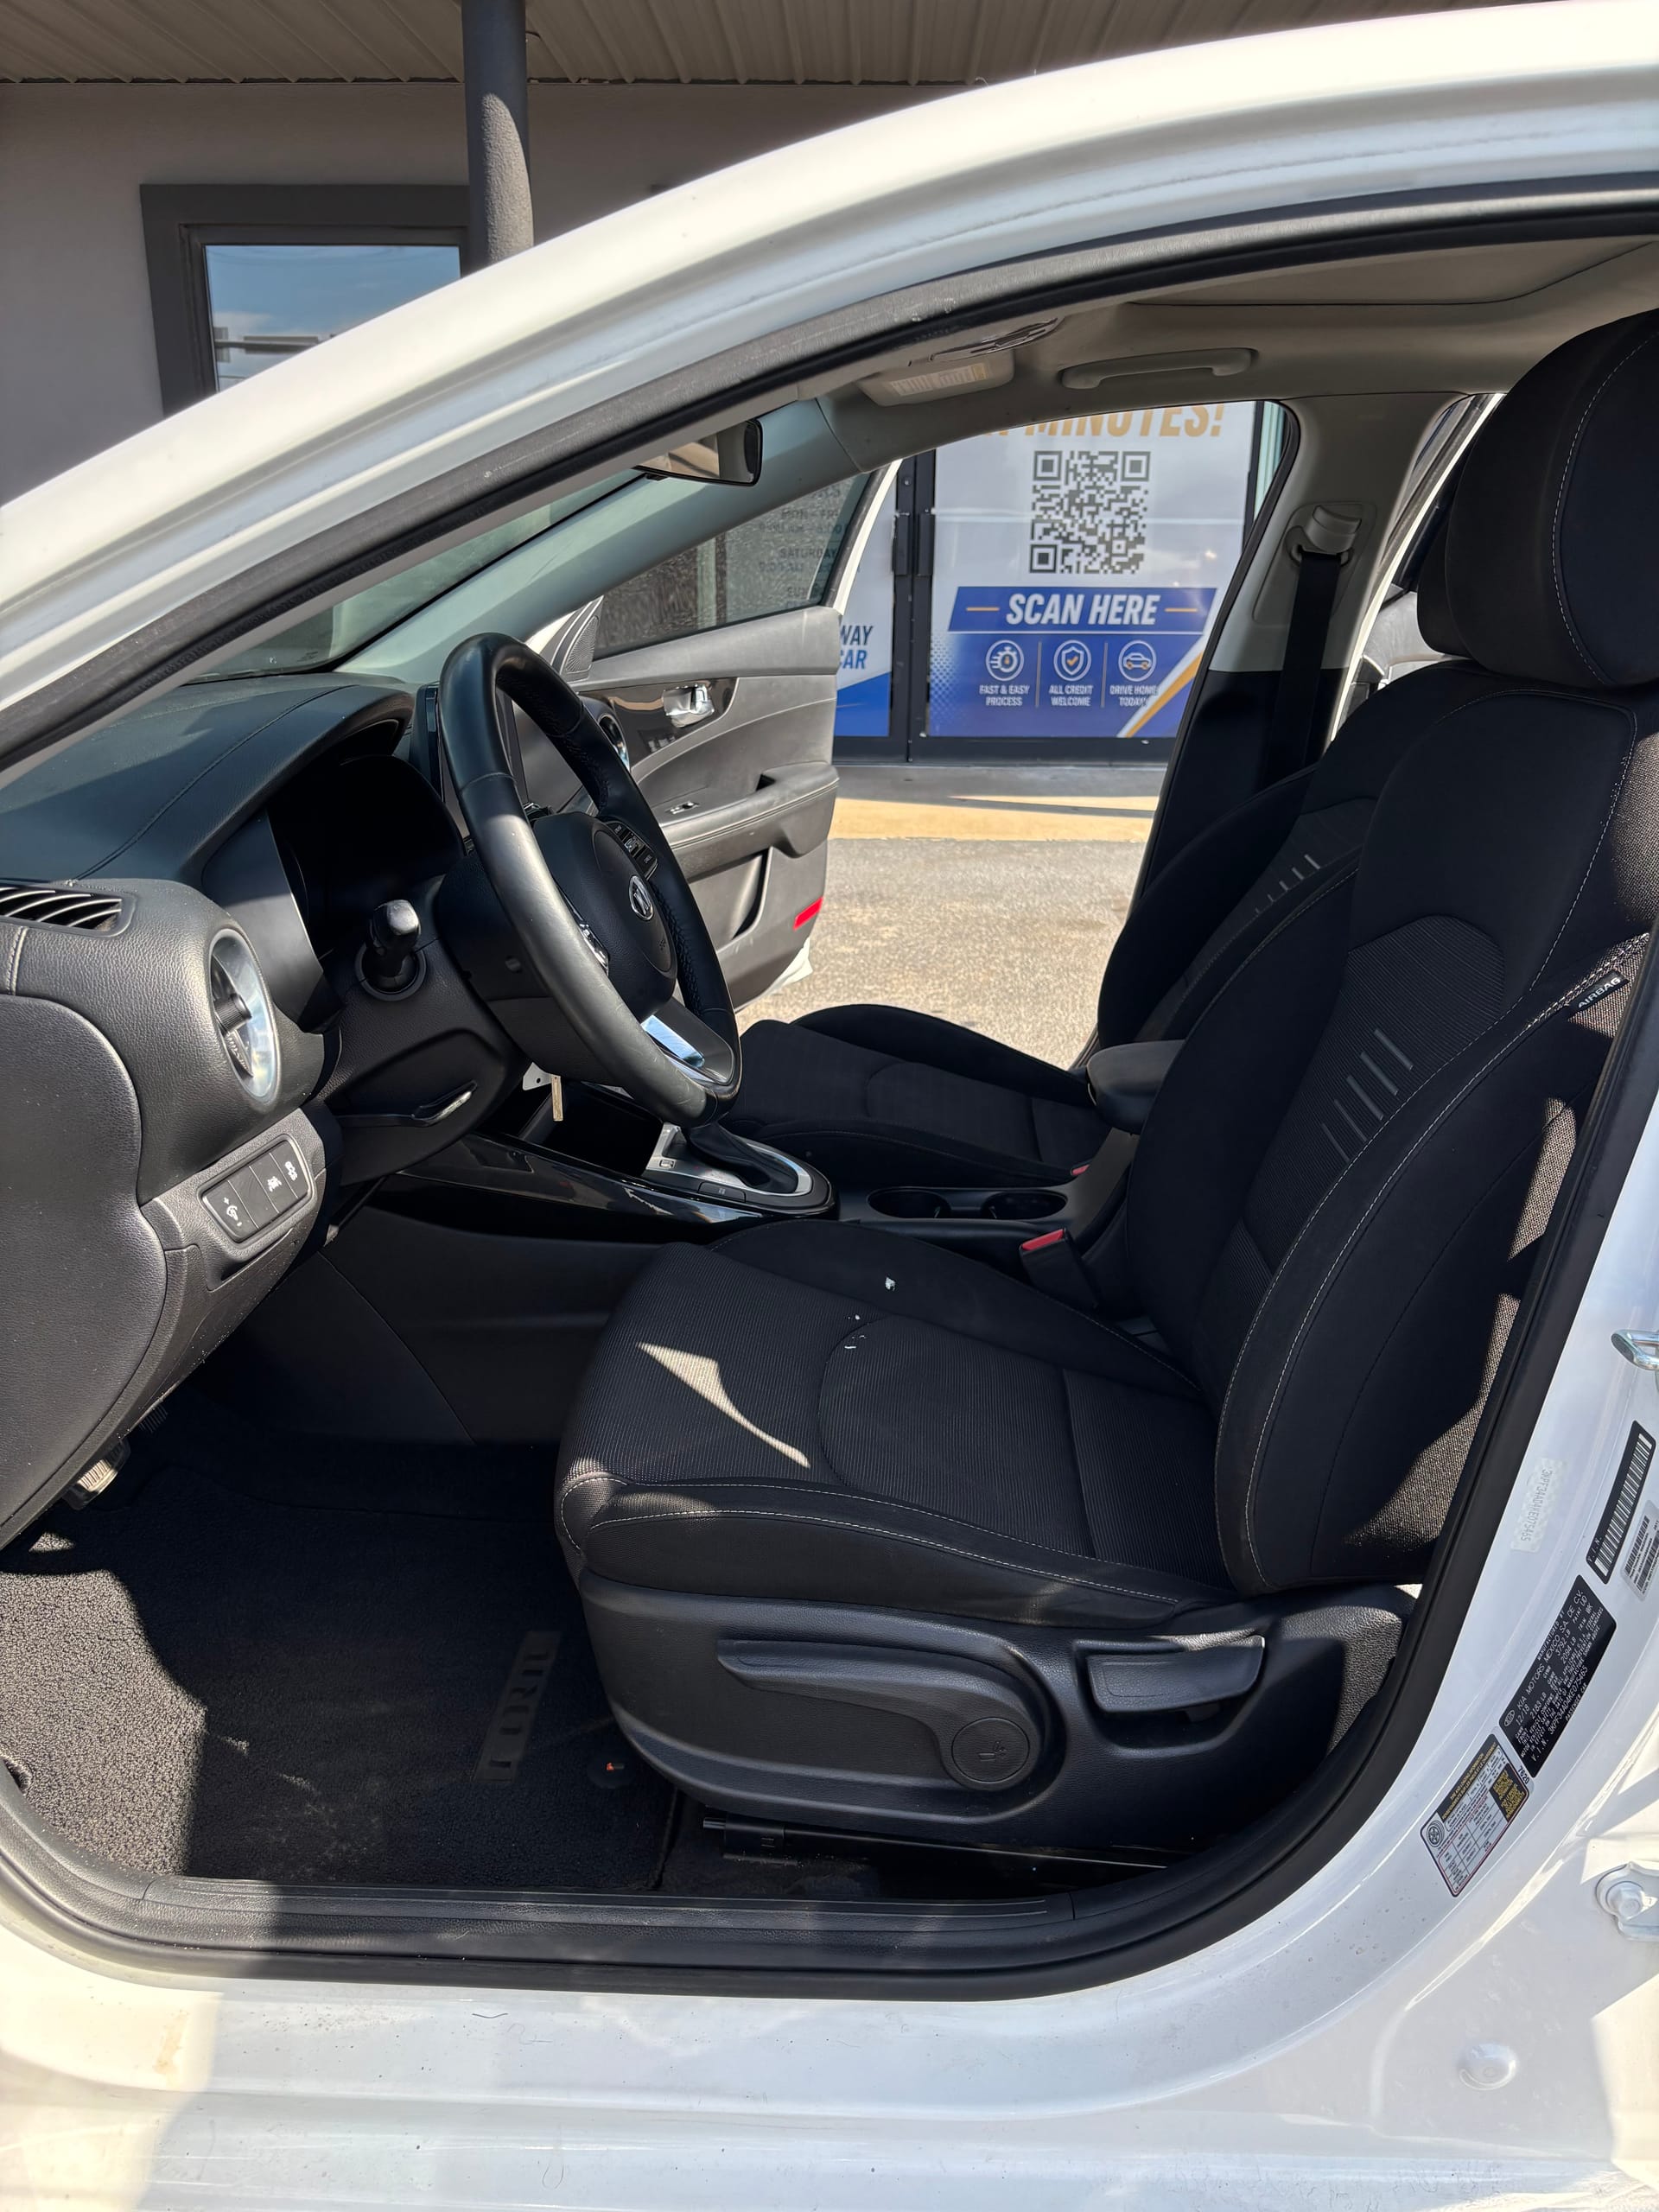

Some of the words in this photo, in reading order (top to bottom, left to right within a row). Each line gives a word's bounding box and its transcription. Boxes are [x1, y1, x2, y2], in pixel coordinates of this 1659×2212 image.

[1006, 594, 1084, 625] SCAN
[1088, 594, 1161, 625] HERE
[841, 649, 867, 669] AR
[979, 684, 999, 694] FAST
[1009, 684, 1030, 694] EASY
[1048, 684, 1062, 694] ALL
[1064, 684, 1093, 694] CREDIT
[1109, 685, 1134, 695] DRIVE
[986, 696, 1022, 706] PROCESS
[1052, 697, 1090, 706] WELCOME
[1578, 977, 1621, 1008] AIRBAG
[1516, 1695, 1526, 1709] KIA
[1526, 1663, 1544, 1694] MOTORS
[1543, 1635, 1560, 1662] MEXICO
[1567, 1605, 1574, 1618] DE
[1516, 1703, 1529, 1726] 12/18
[1554, 1637, 1567, 1656] 3792
[1564, 1628, 1571, 1638] LB
[1529, 1700, 1541, 1719] 2183
[1540, 1691, 1546, 1701] LB
[1560, 1645, 1572, 1663] 2094
[1569, 1636, 1576, 1646] LB
